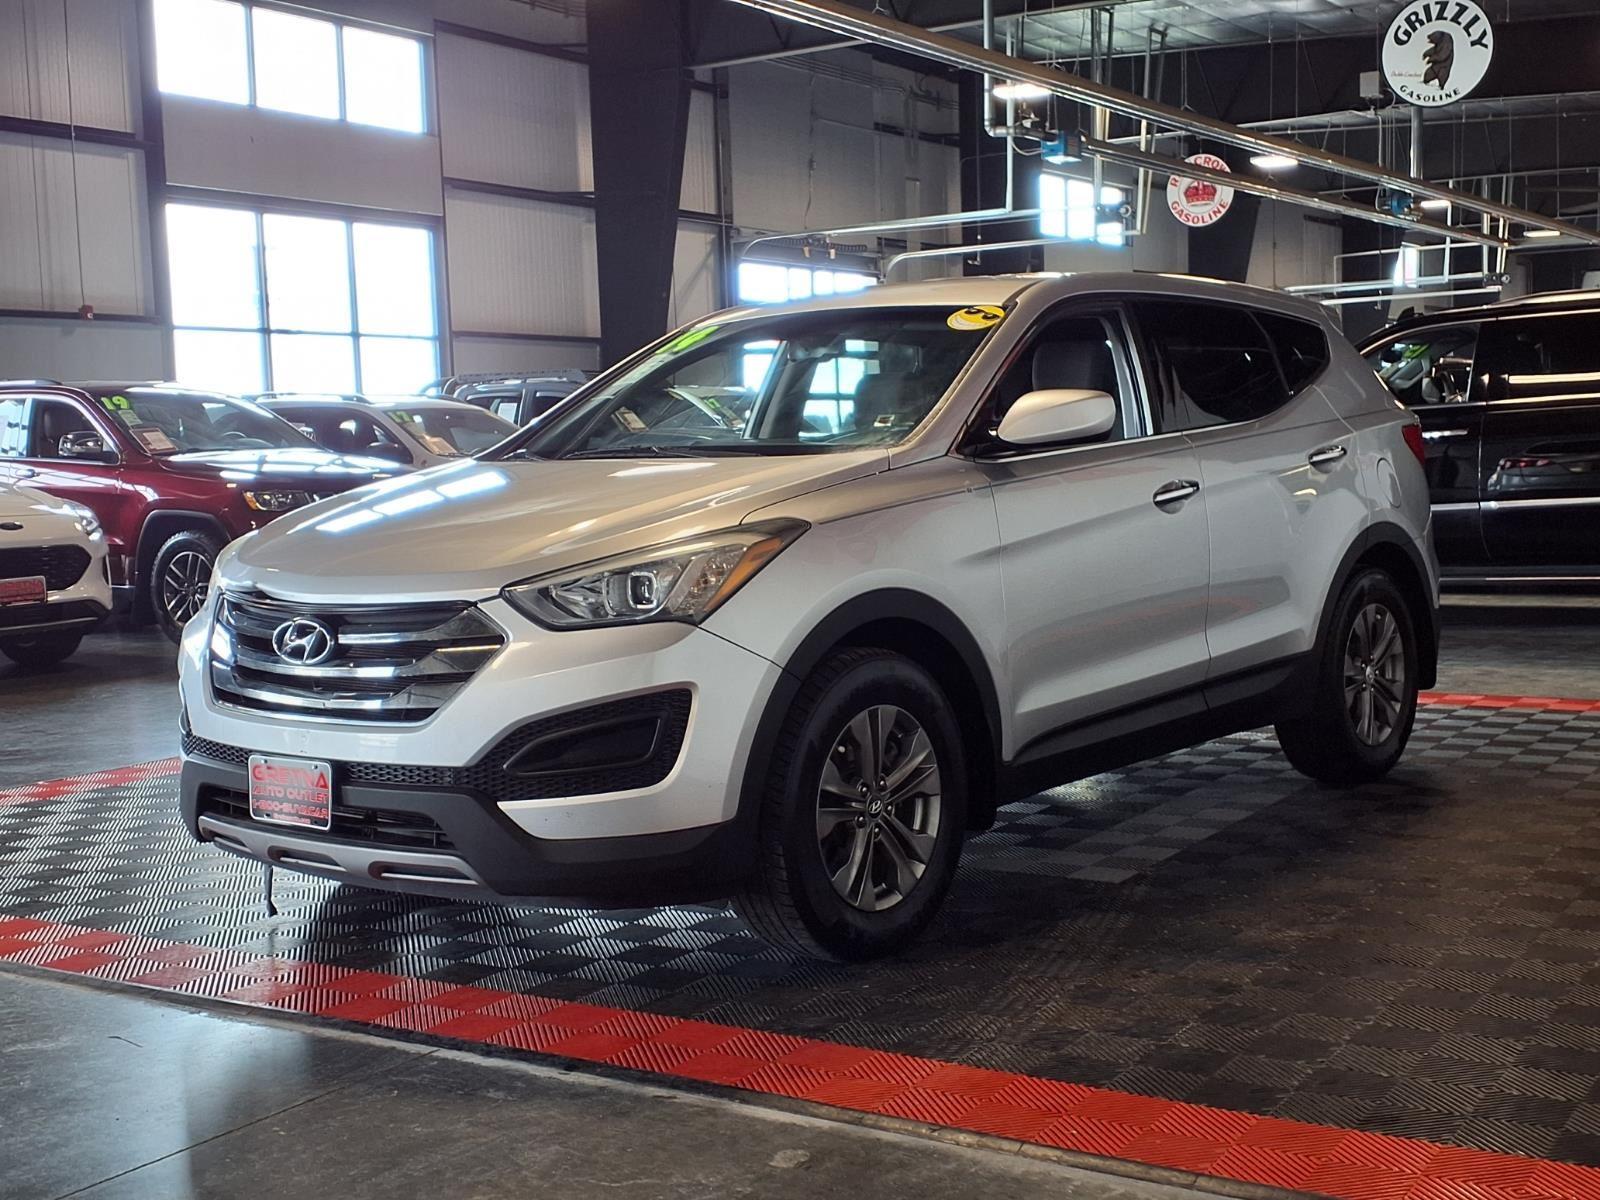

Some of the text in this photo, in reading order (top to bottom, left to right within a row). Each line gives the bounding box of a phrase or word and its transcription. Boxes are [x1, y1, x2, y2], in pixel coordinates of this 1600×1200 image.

[1393, 0, 1489, 50] GRIZZLY
[1399, 84, 1461, 103] GASOLINE
[1171, 199, 1229, 224] GASOLINE
[100, 395, 129, 411] 19
[252, 765, 329, 789] GRETNA
[253, 785, 329, 804] AUTO OUTLET
